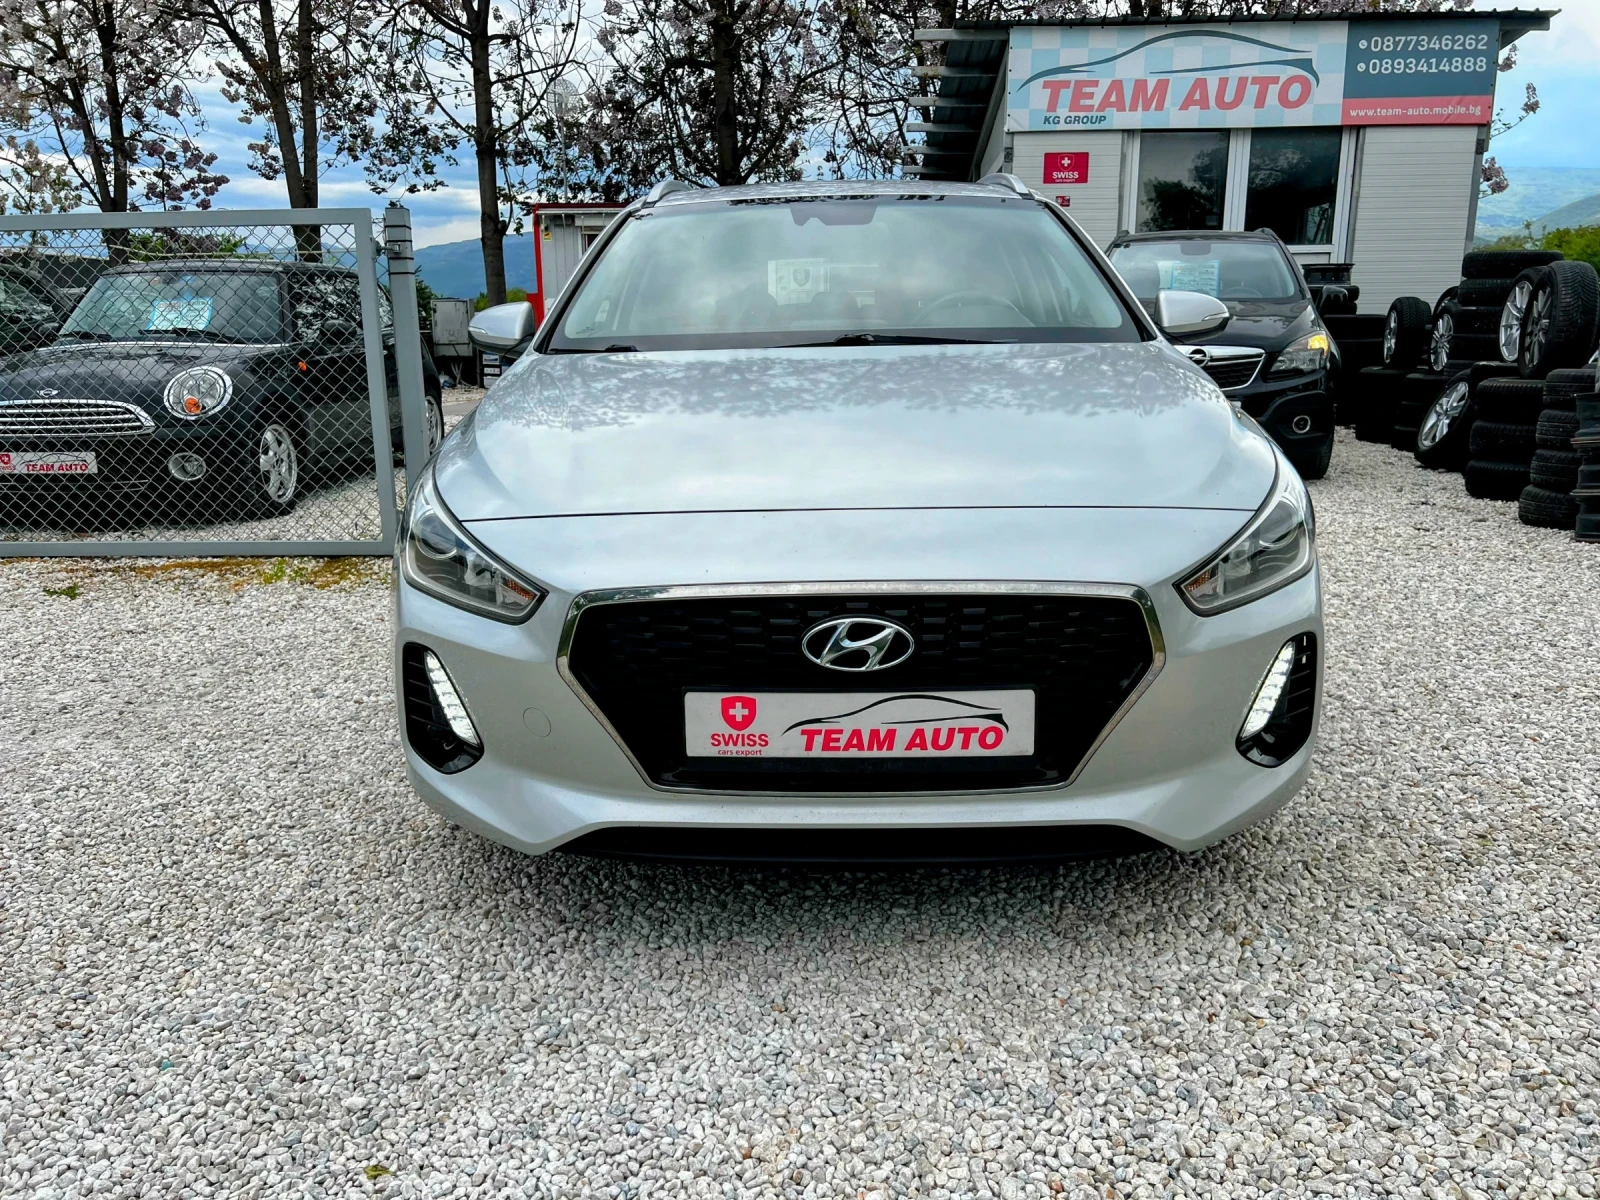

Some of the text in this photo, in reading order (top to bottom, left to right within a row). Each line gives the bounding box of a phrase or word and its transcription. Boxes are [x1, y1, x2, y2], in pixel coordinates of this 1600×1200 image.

[1371, 35, 1488, 52] 0877346262
[1369, 57, 1487, 74] 0893414888
[1042, 74, 1312, 113] TEAM AUTO
[1350, 105, 1481, 117] www.team-auto.mobile.bg
[1043, 115, 1107, 125] KG GROUP
[26, 463, 88, 472] TEAM AUTO
[710, 733, 769, 747] SWISS
[800, 726, 1003, 752] TEAM AUTO
